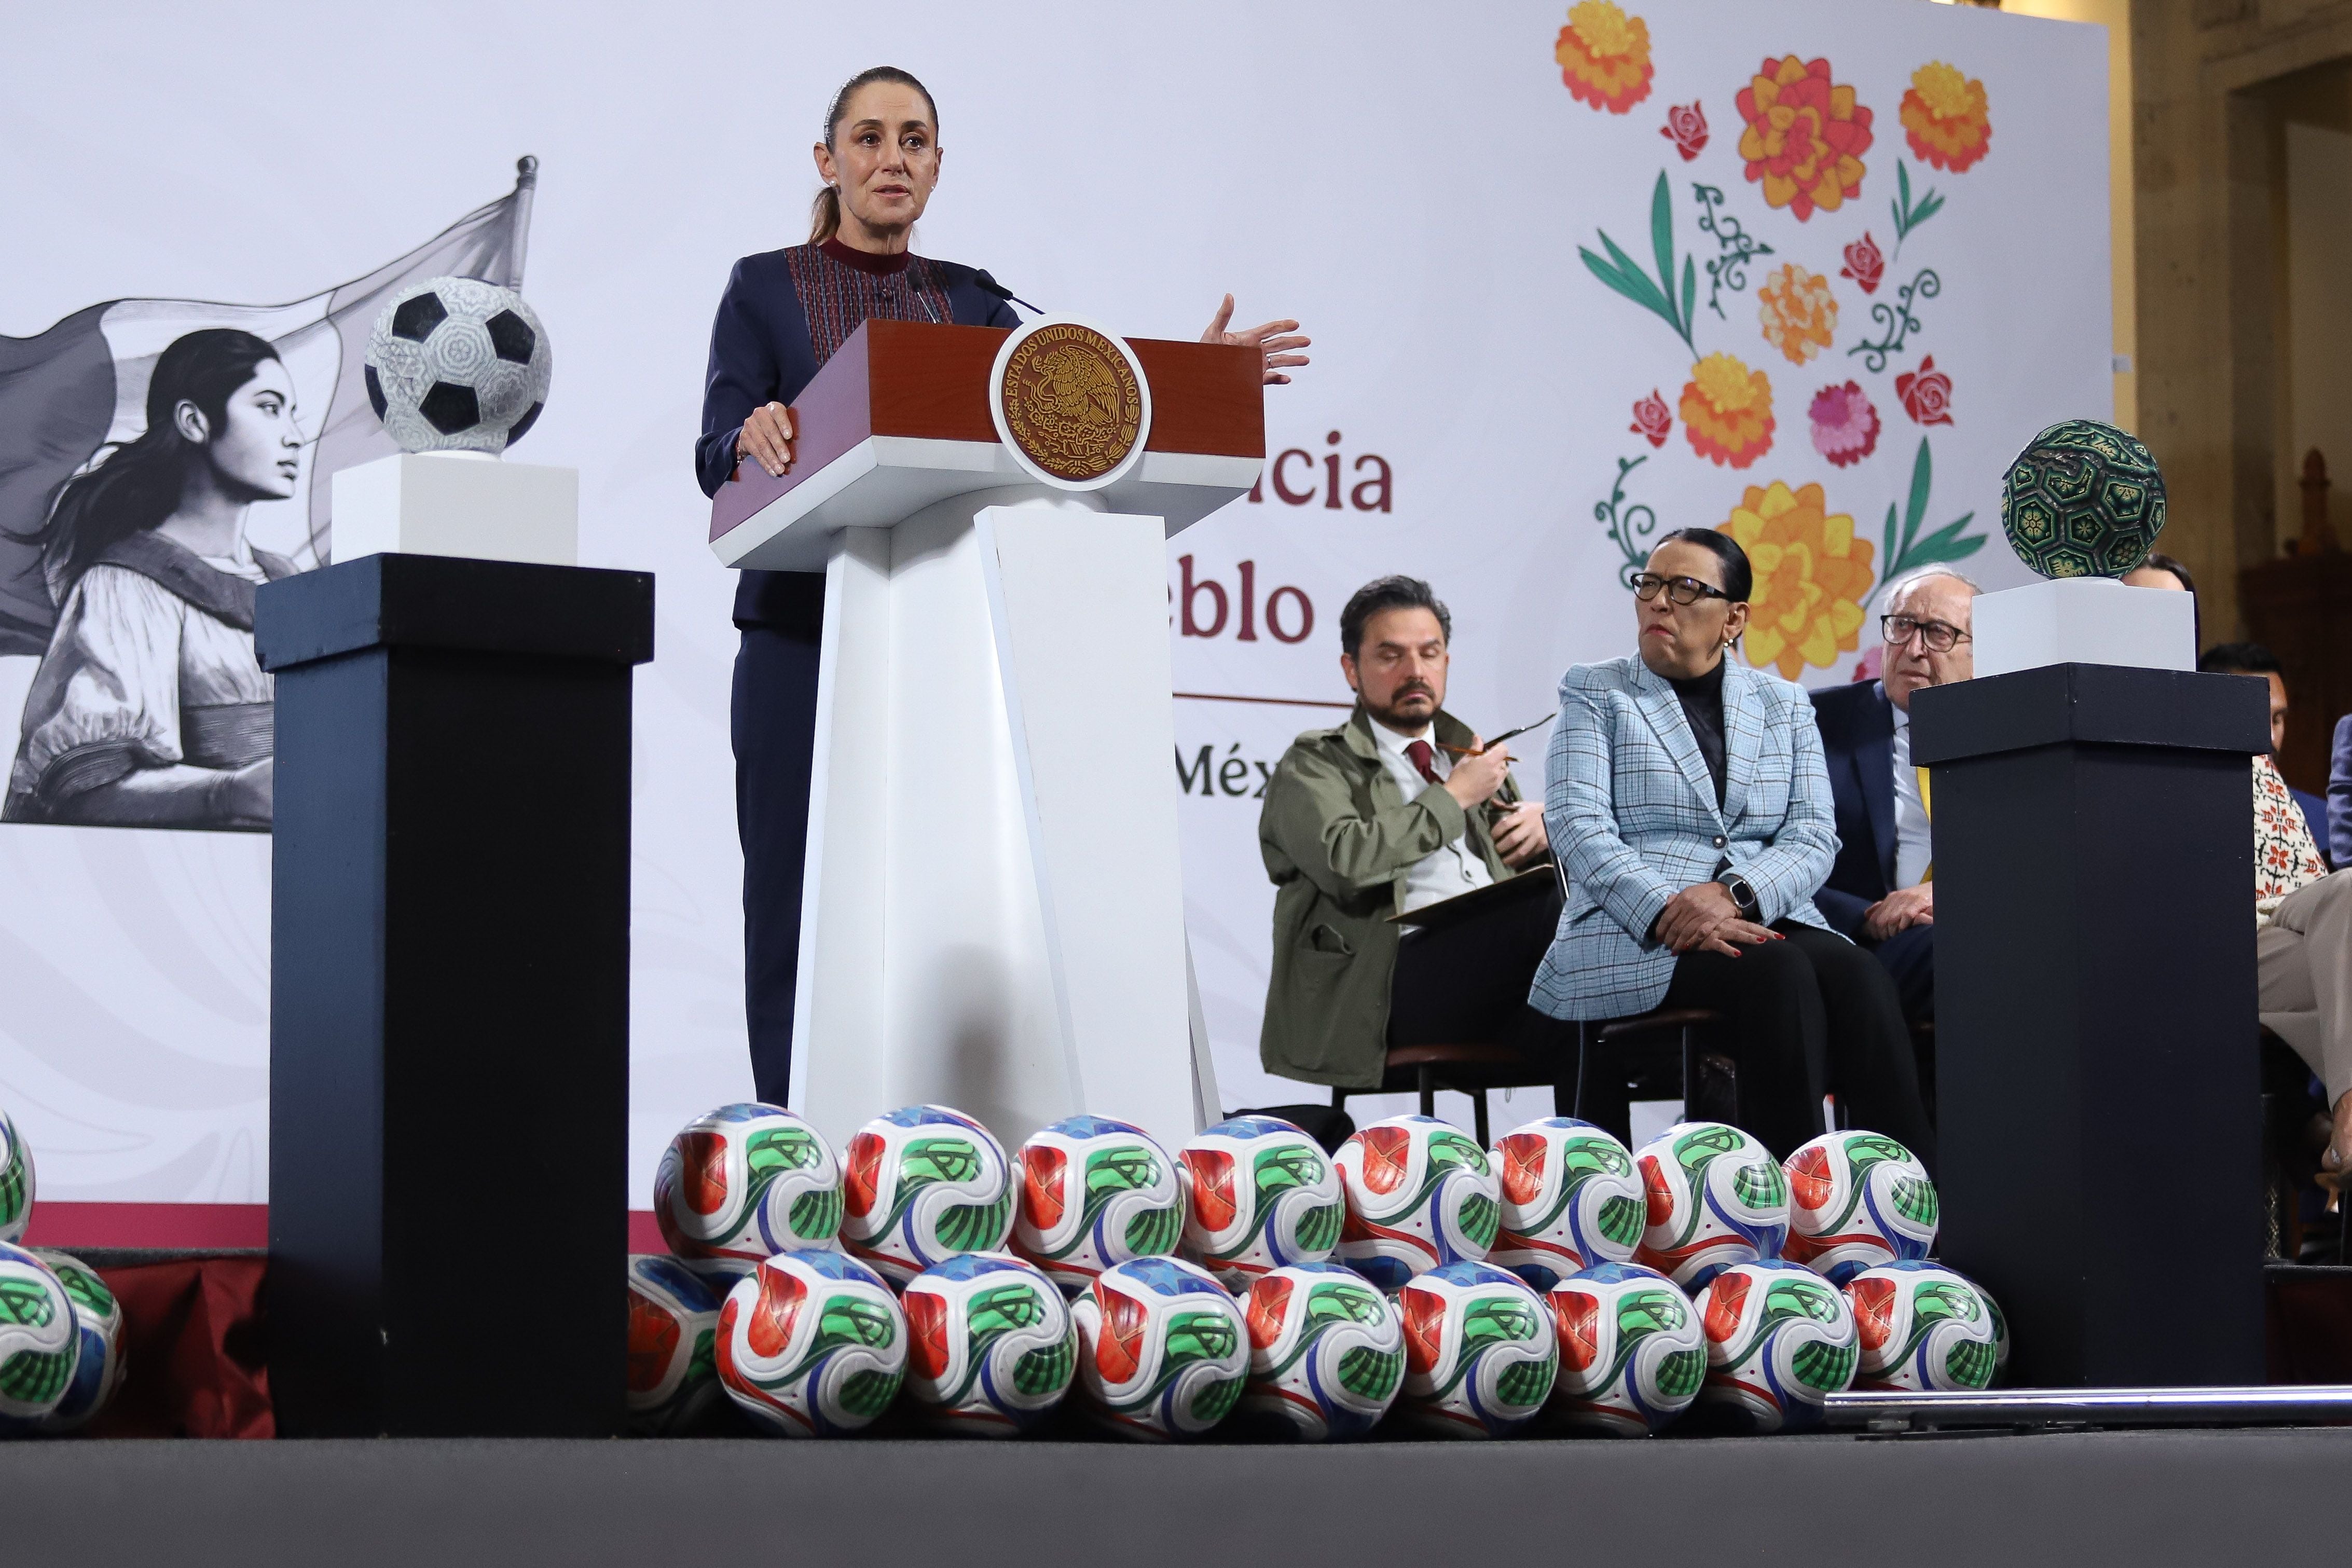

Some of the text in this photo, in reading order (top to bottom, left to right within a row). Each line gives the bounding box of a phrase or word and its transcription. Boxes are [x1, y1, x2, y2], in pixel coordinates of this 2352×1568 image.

[1005, 327, 1139, 405] ESTADOS UNIDOS MEXICANOS
[1167, 555, 1313, 643] blo
